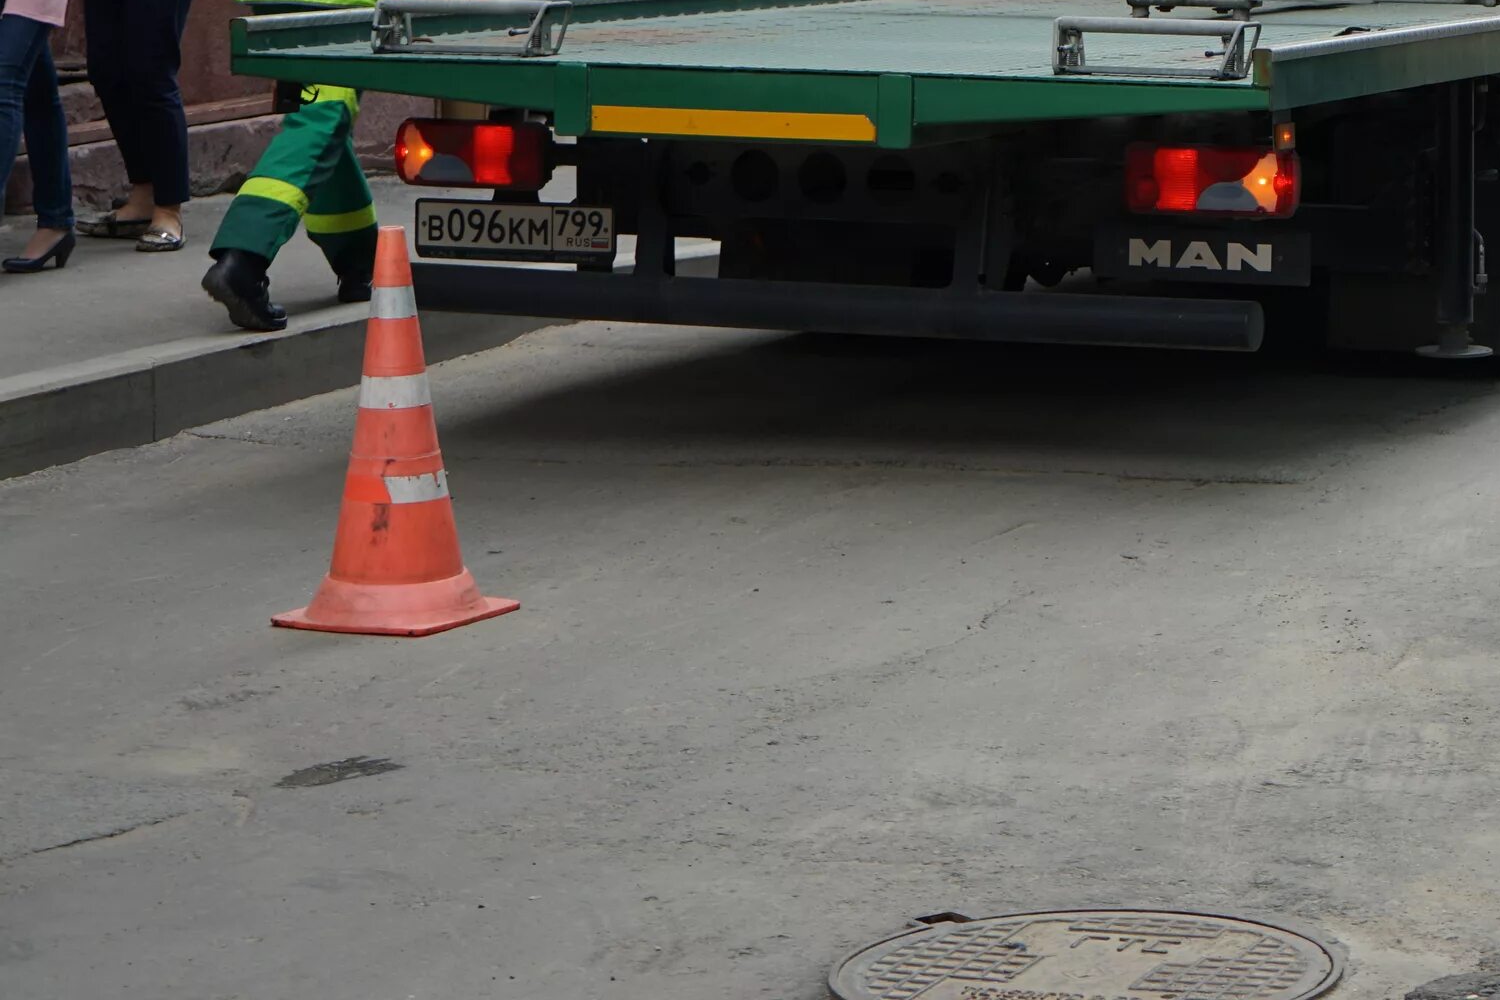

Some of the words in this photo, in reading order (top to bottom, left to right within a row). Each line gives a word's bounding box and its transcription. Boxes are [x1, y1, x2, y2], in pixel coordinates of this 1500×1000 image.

[555, 209, 604, 237] 799
[566, 237, 590, 248] RUS
[1128, 238, 1273, 273] MAN
